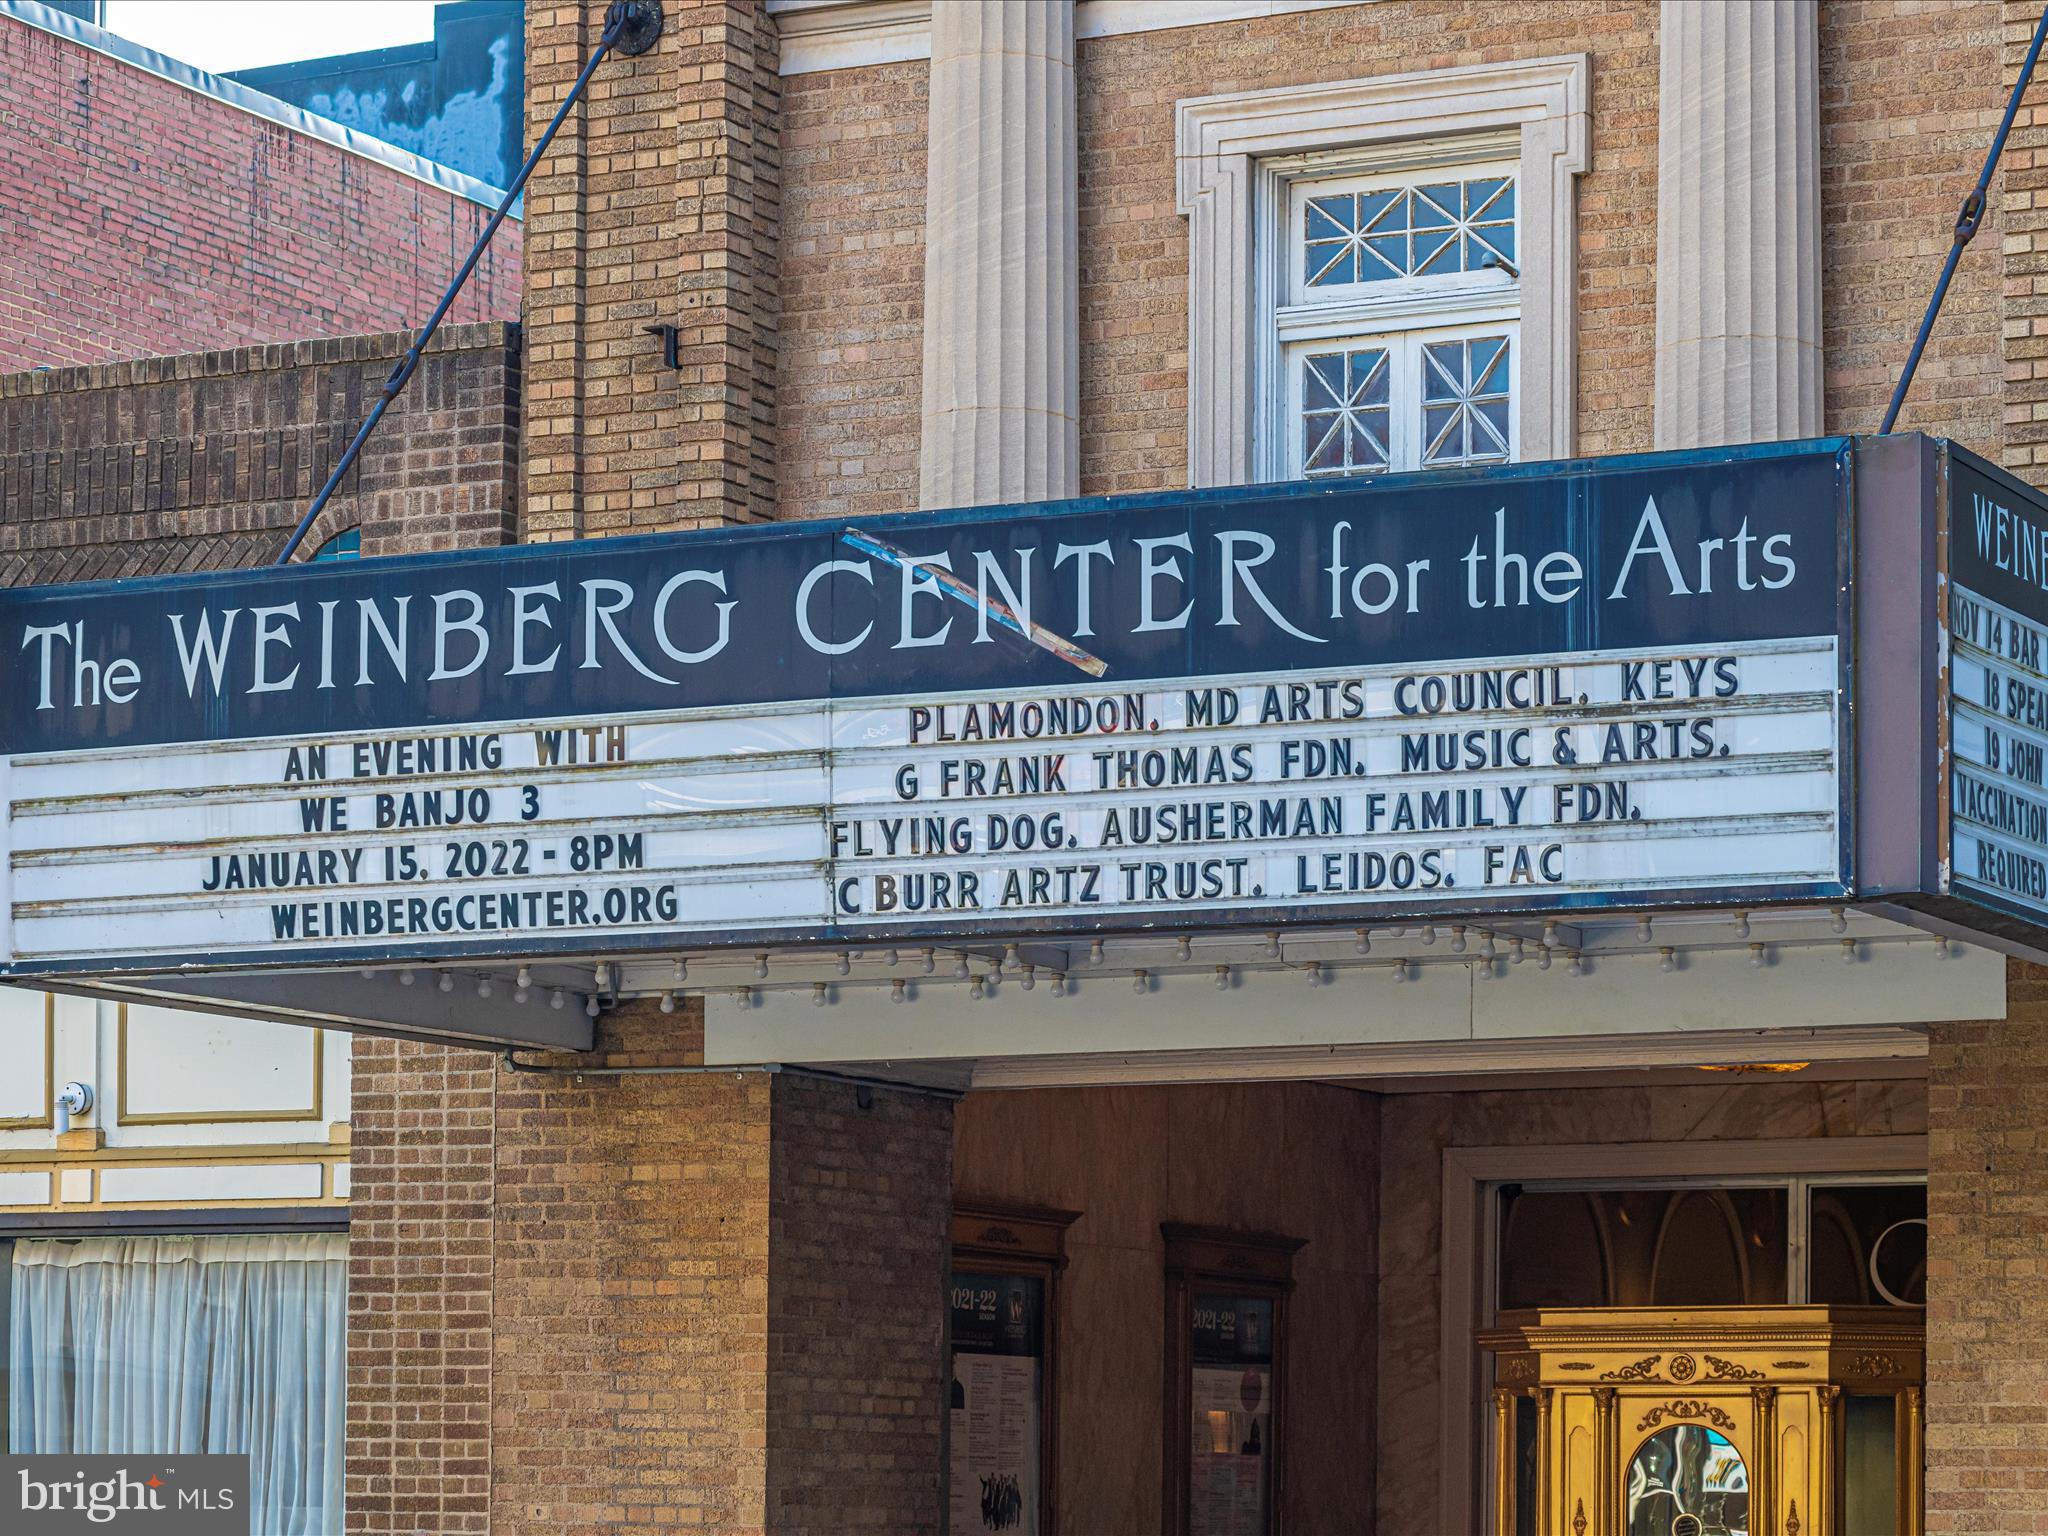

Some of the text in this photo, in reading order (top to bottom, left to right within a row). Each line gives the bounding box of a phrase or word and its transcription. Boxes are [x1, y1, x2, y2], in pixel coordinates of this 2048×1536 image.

[22, 494, 1796, 710] The WEINBERG CENTER for the Arts
[1986, 609, 2002, 655] 14
[2010, 620, 2040, 671] BAR
[1184, 687, 1239, 727] MD
[1259, 679, 1364, 724] ARTS
[1620, 655, 1739, 700] KEYS
[1985, 668, 2048, 732] 18 SPEA
[284, 725, 626, 781] AN EVENING WITH
[895, 763, 919, 800] G
[940, 754, 1067, 797] FRANK
[1093, 742, 1254, 790] THOMAS
[1400, 726, 1532, 772] MUSIC
[1553, 726, 1577, 765] &
[1985, 725, 2044, 786] 19 JOHN
[300, 784, 541, 833] WE BANJO 3
[830, 816, 972, 857] FLYING
[1099, 795, 1343, 846] AUSHERMAN
[1365, 785, 1528, 833] FAMILY
[1957, 772, 2048, 845] VACCINATION
[202, 847, 364, 892] JANUARY
[445, 838, 530, 878] 2022
[570, 832, 644, 871] 8PM
[838, 876, 860, 914] C
[874, 869, 980, 913] BURR
[1001, 863, 1101, 907] ARTZ
[1484, 843, 1563, 885] FAC
[1977, 839, 2047, 900] REQUIRED
[951, 1287, 997, 1311] 021-22
